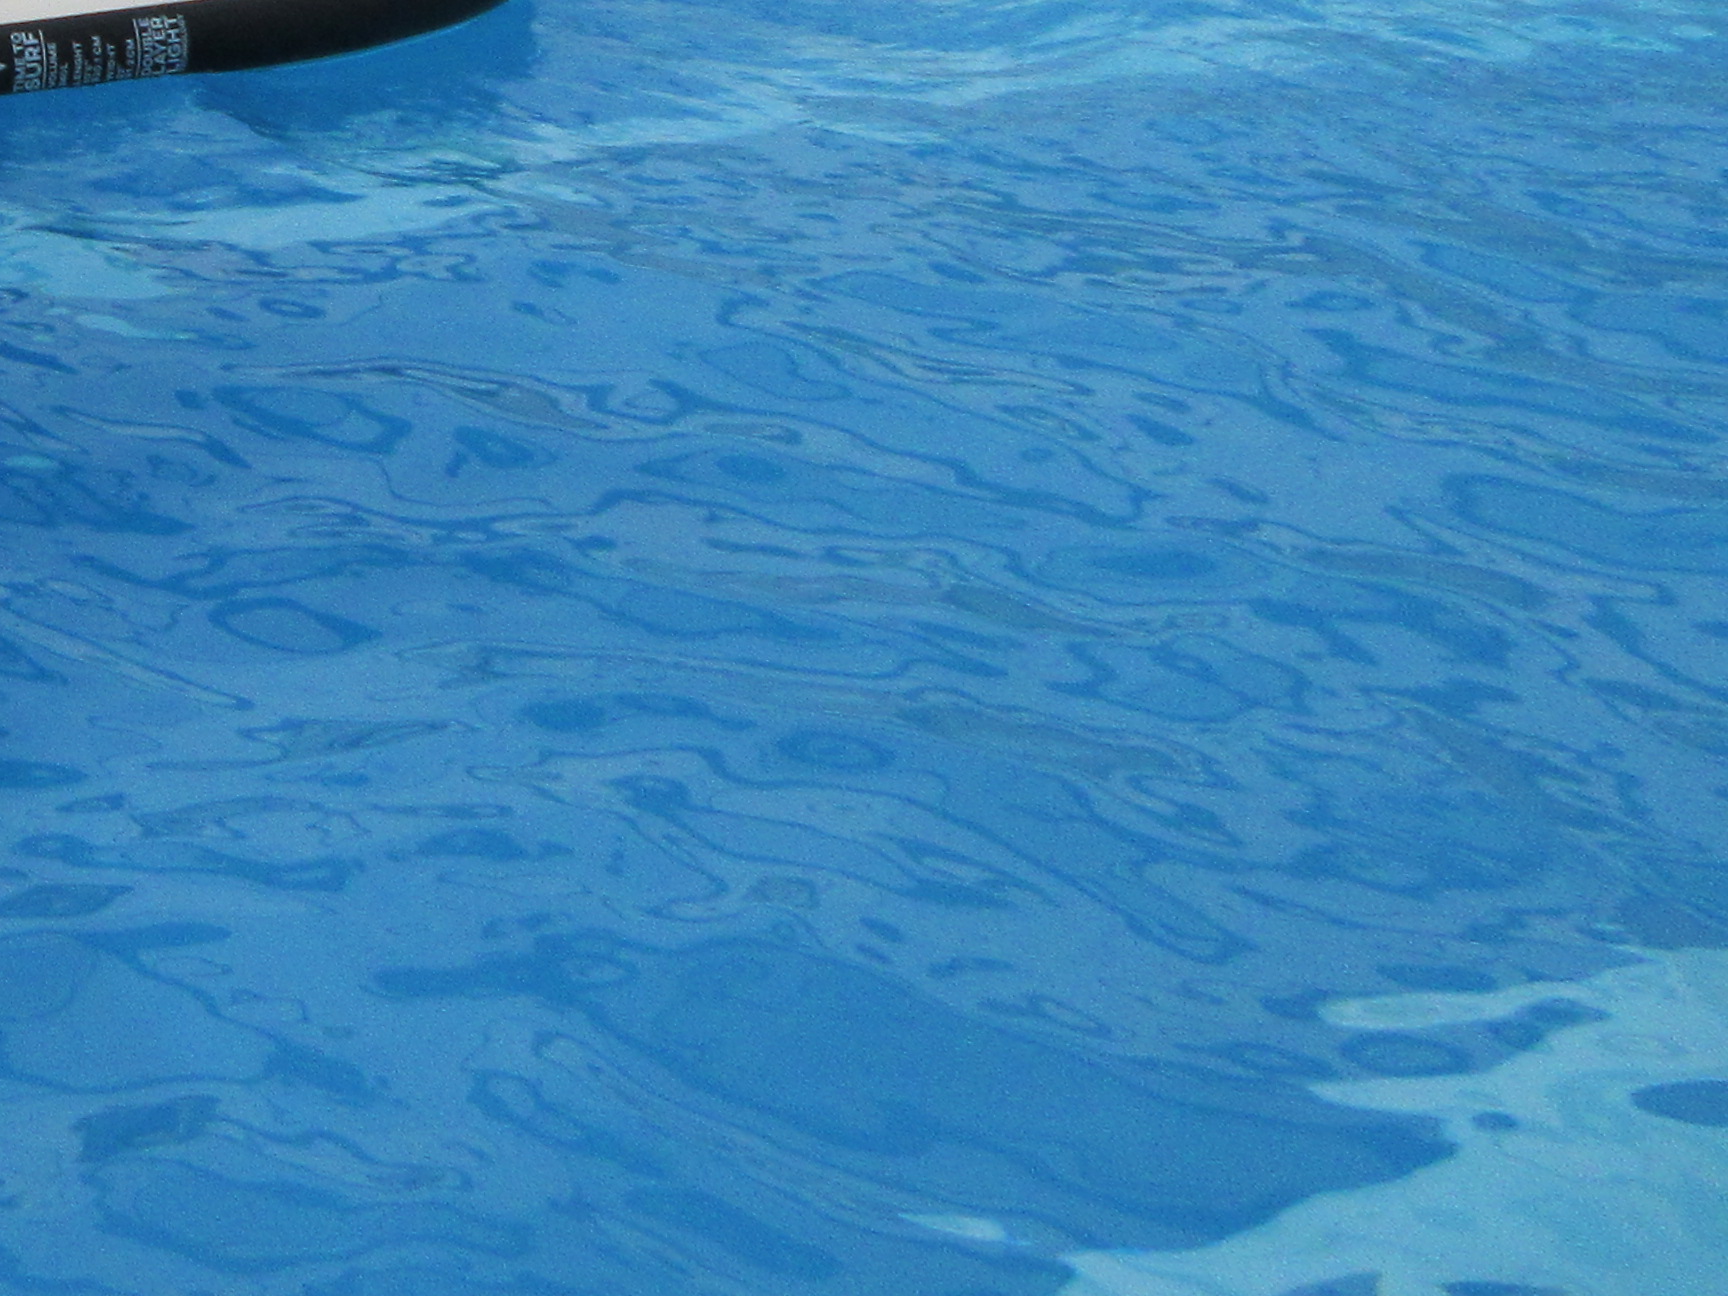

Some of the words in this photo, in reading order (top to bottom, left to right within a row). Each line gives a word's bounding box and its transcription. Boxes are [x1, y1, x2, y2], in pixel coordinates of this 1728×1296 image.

[10, 32, 23, 54] TO
[22, 32, 42, 91] SURF
[139, 17, 151, 77] DOUBLE
[150, 16, 166, 76] LAYER
[165, 16, 180, 74] LIGHT
[13, 57, 26, 92] TIME
